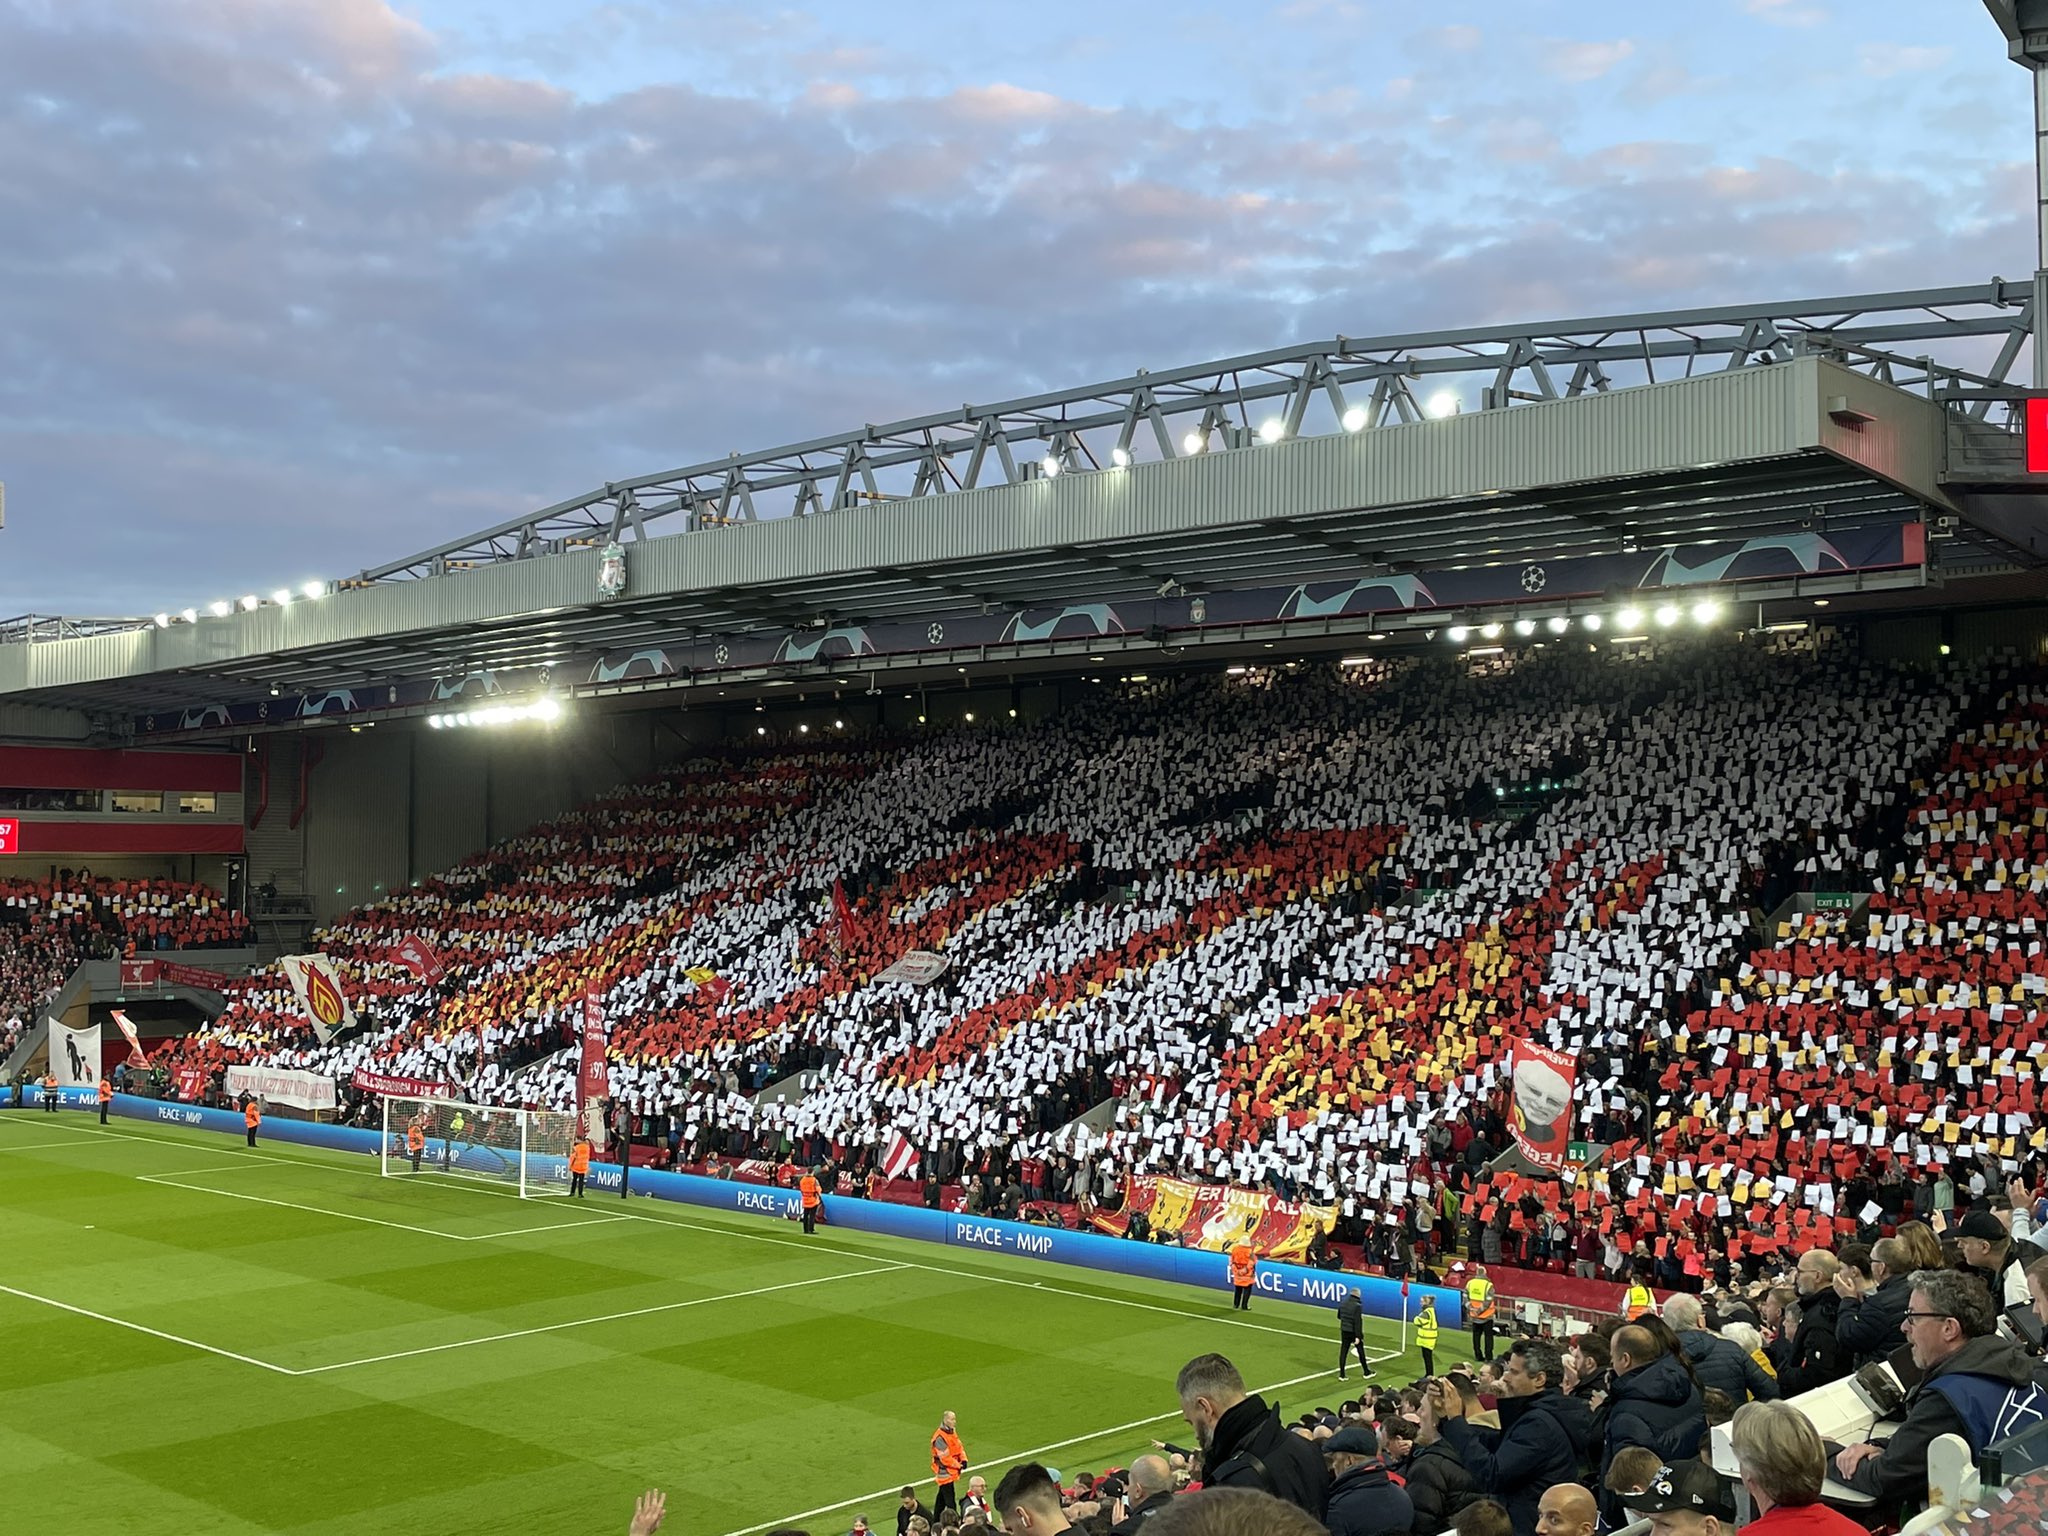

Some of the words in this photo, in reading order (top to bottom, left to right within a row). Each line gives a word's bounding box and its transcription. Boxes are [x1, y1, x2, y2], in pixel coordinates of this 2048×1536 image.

[1817, 899, 1833, 907] EXIT
[158, 1107, 180, 1121] PEACE
[597, 1170, 622, 1187] МИР
[737, 1190, 775, 1211] PEACE
[1222, 1186, 1271, 1211] WALK
[957, 1223, 1002, 1246] PEACE
[1017, 1232, 1053, 1254] МИР
[1302, 1278, 1347, 1302] МИР
